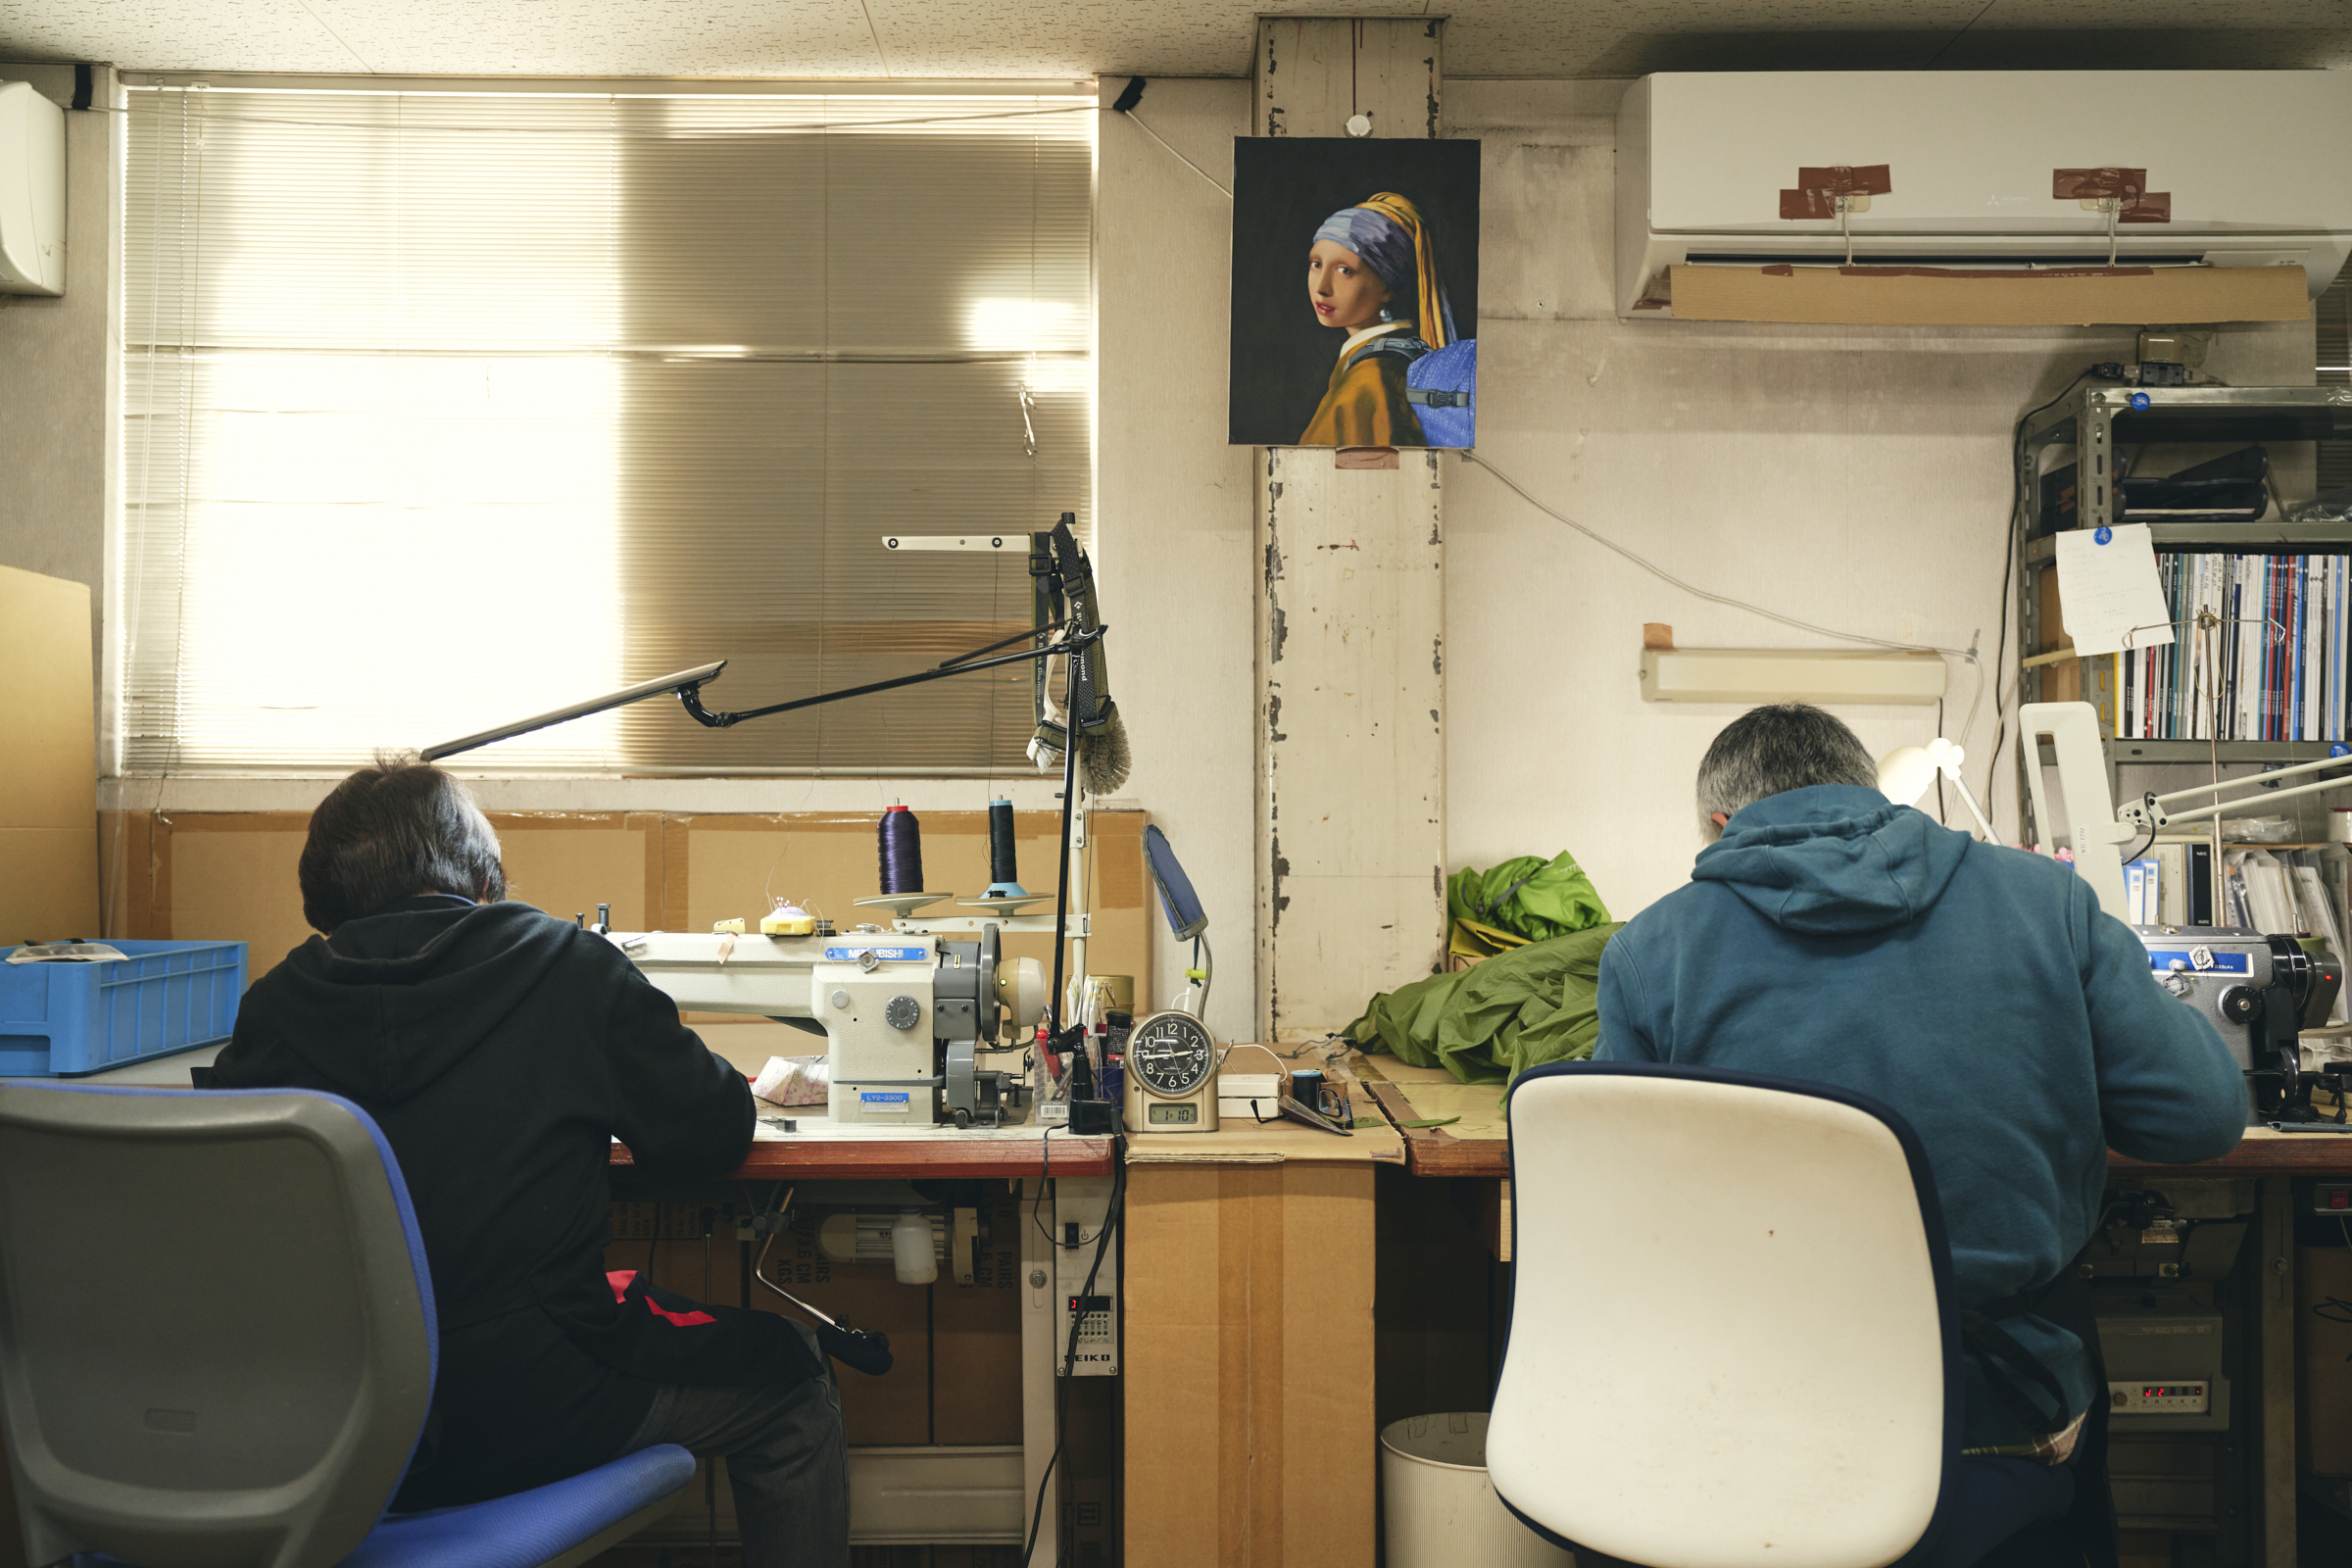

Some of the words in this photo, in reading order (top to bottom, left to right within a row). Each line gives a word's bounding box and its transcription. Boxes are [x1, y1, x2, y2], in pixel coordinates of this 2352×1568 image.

[849, 949, 905, 958] MIBISHI
[1156, 1027, 1164, 1039] 11
[1167, 1023, 1178, 1035] 12
[1183, 1027, 1187, 1039] 1
[1145, 1036, 1155, 1048] 10
[1190, 1036, 1199, 1048] 2
[1141, 1050, 1150, 1061] 9
[1196, 1049, 1204, 1061] 3
[1147, 1062, 1154, 1075] 8
[1190, 1062, 1199, 1075] 4
[1156, 1073, 1164, 1085] 7
[1168, 1075, 1177, 1088] 6
[1181, 1073, 1190, 1085] 5
[777, 1259, 792, 1285] KGS
[797, 1263, 812, 1284] CM
[815, 1252, 831, 1284] AIRS
[998, 1251, 1013, 1289] PAIRS
